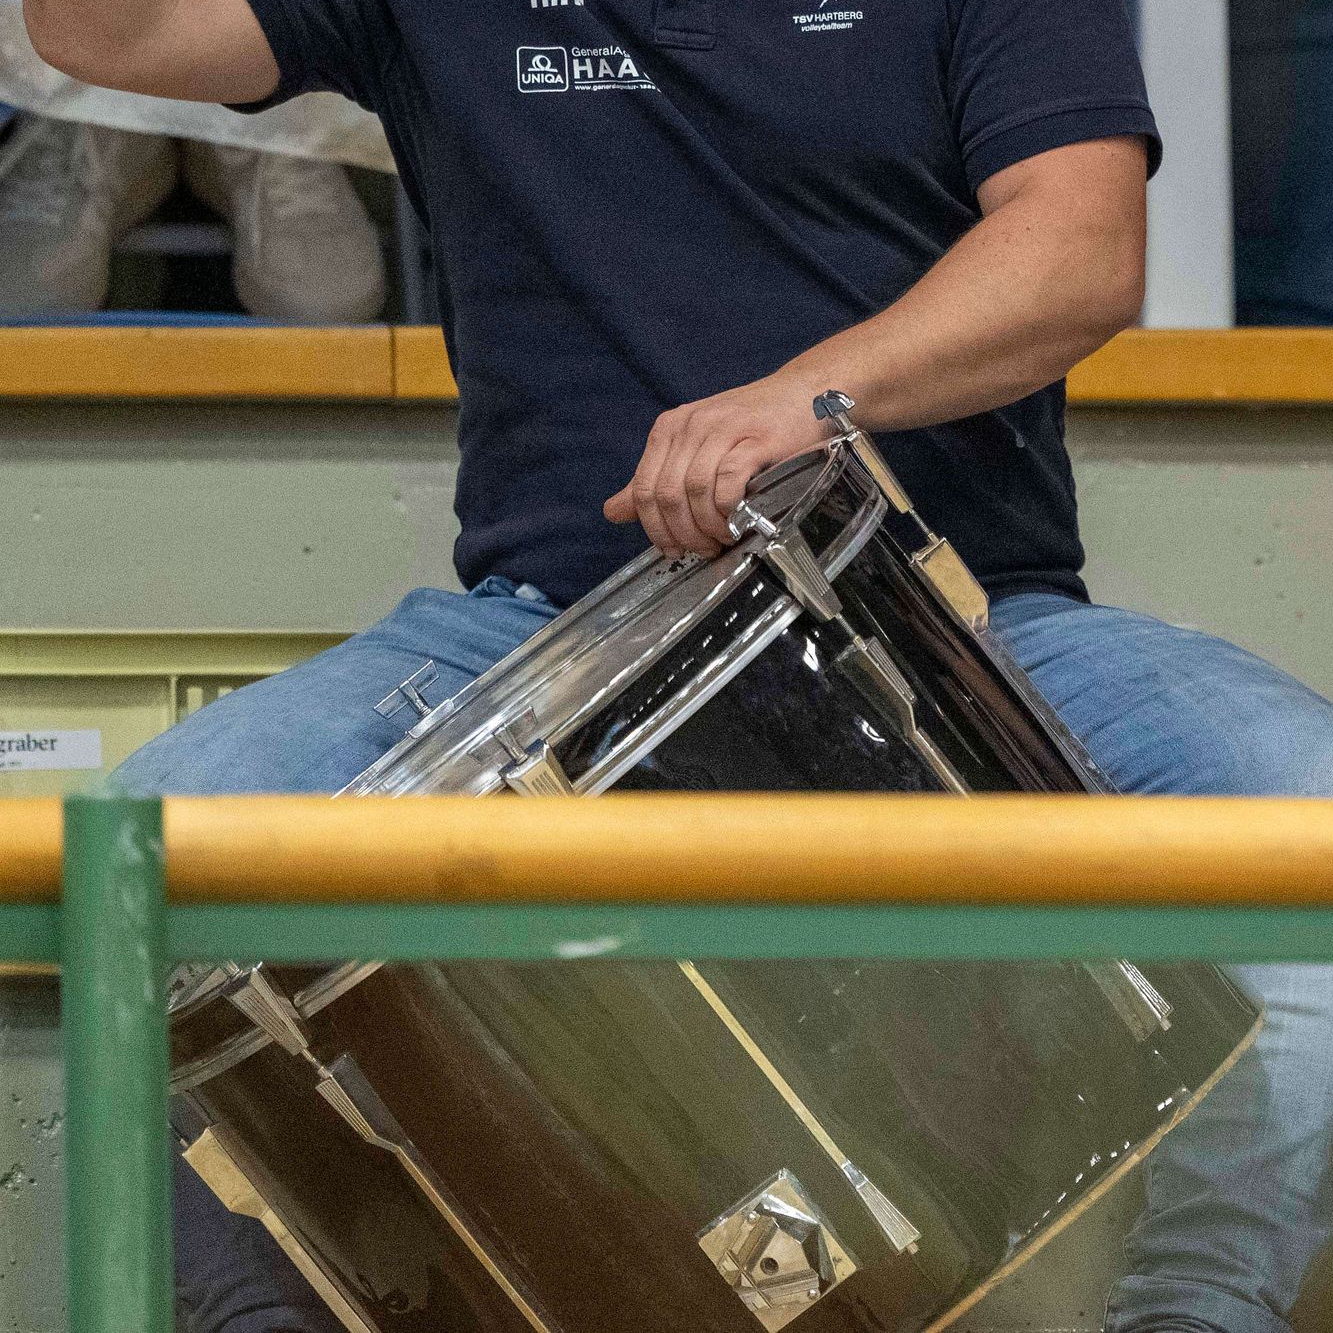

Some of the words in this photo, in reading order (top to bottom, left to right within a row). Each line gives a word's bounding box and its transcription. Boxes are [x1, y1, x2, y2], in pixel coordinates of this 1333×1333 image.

[792, 15, 813, 24] TSV
[814, 10, 864, 22] HARTBERG
[572, 58, 641, 80] HAA
[521, 73, 565, 85] UNIQA
